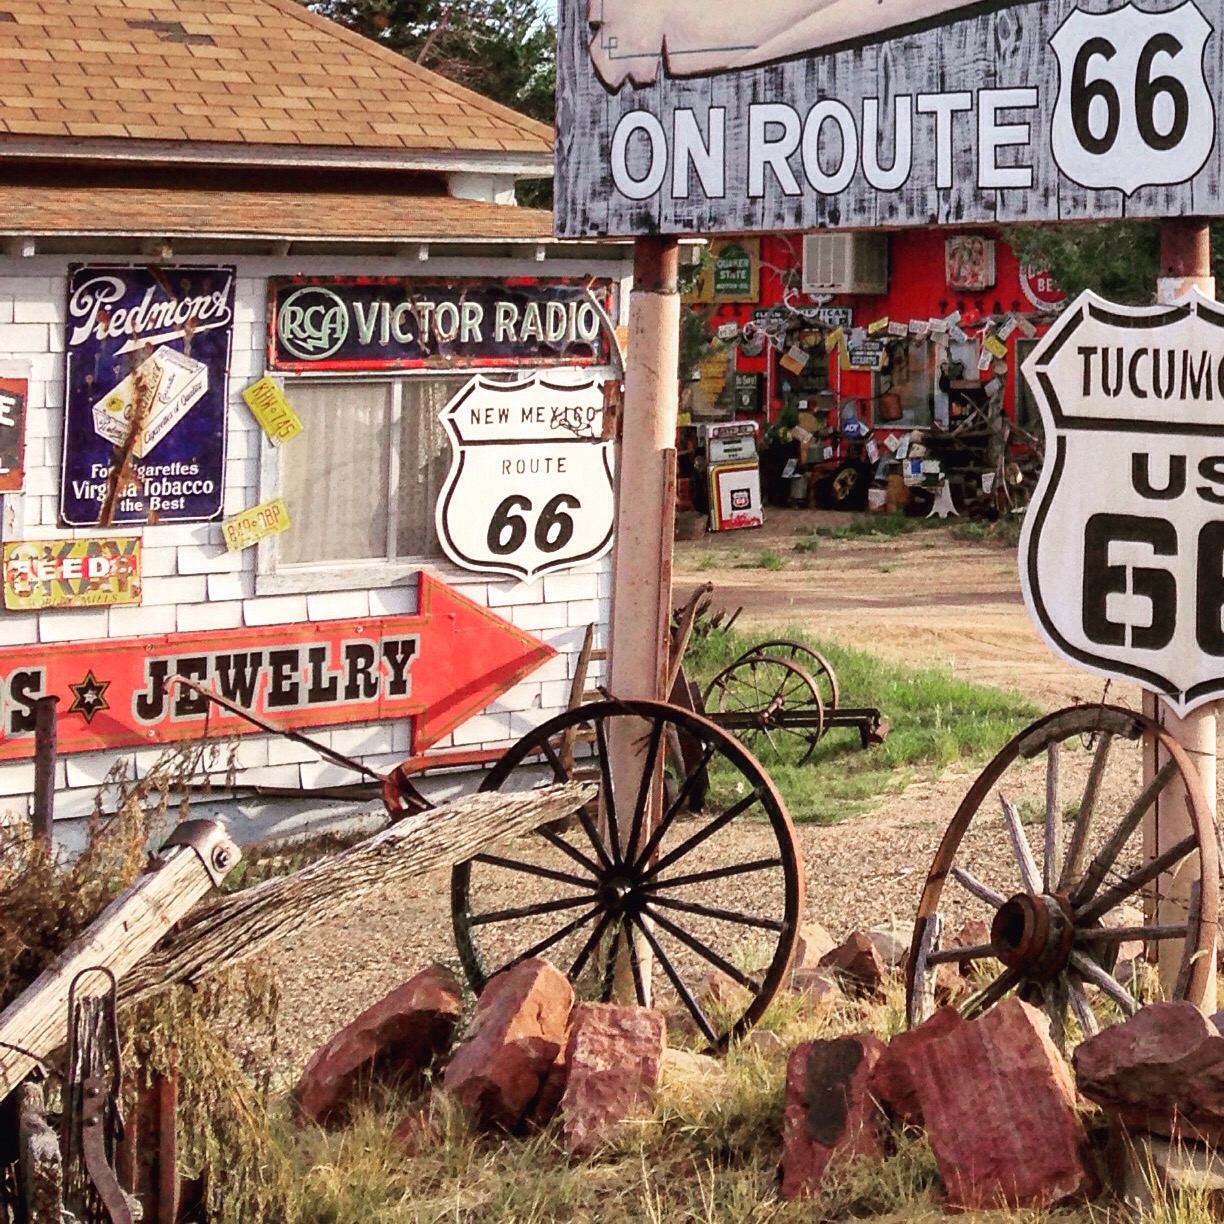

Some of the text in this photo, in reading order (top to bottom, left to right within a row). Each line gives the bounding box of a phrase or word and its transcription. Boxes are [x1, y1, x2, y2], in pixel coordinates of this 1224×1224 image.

[610, 33, 1189, 201] ON ROUTE 66
[717, 259, 750, 269] QUAKER
[720, 270, 747, 279] STATE
[69, 275, 232, 349] Piedmont
[281, 301, 600, 345] RCA VICTOR RADIO
[470, 406, 597, 425] NEW MEXICO
[127, 461, 200, 483] garettes
[502, 457, 567, 475] ROUTE
[72, 477, 214, 502] Virgia Tobacco
[120, 495, 185, 512] the Best
[487, 493, 582, 555] 66
[134, 635, 419, 723] JEWELRY
